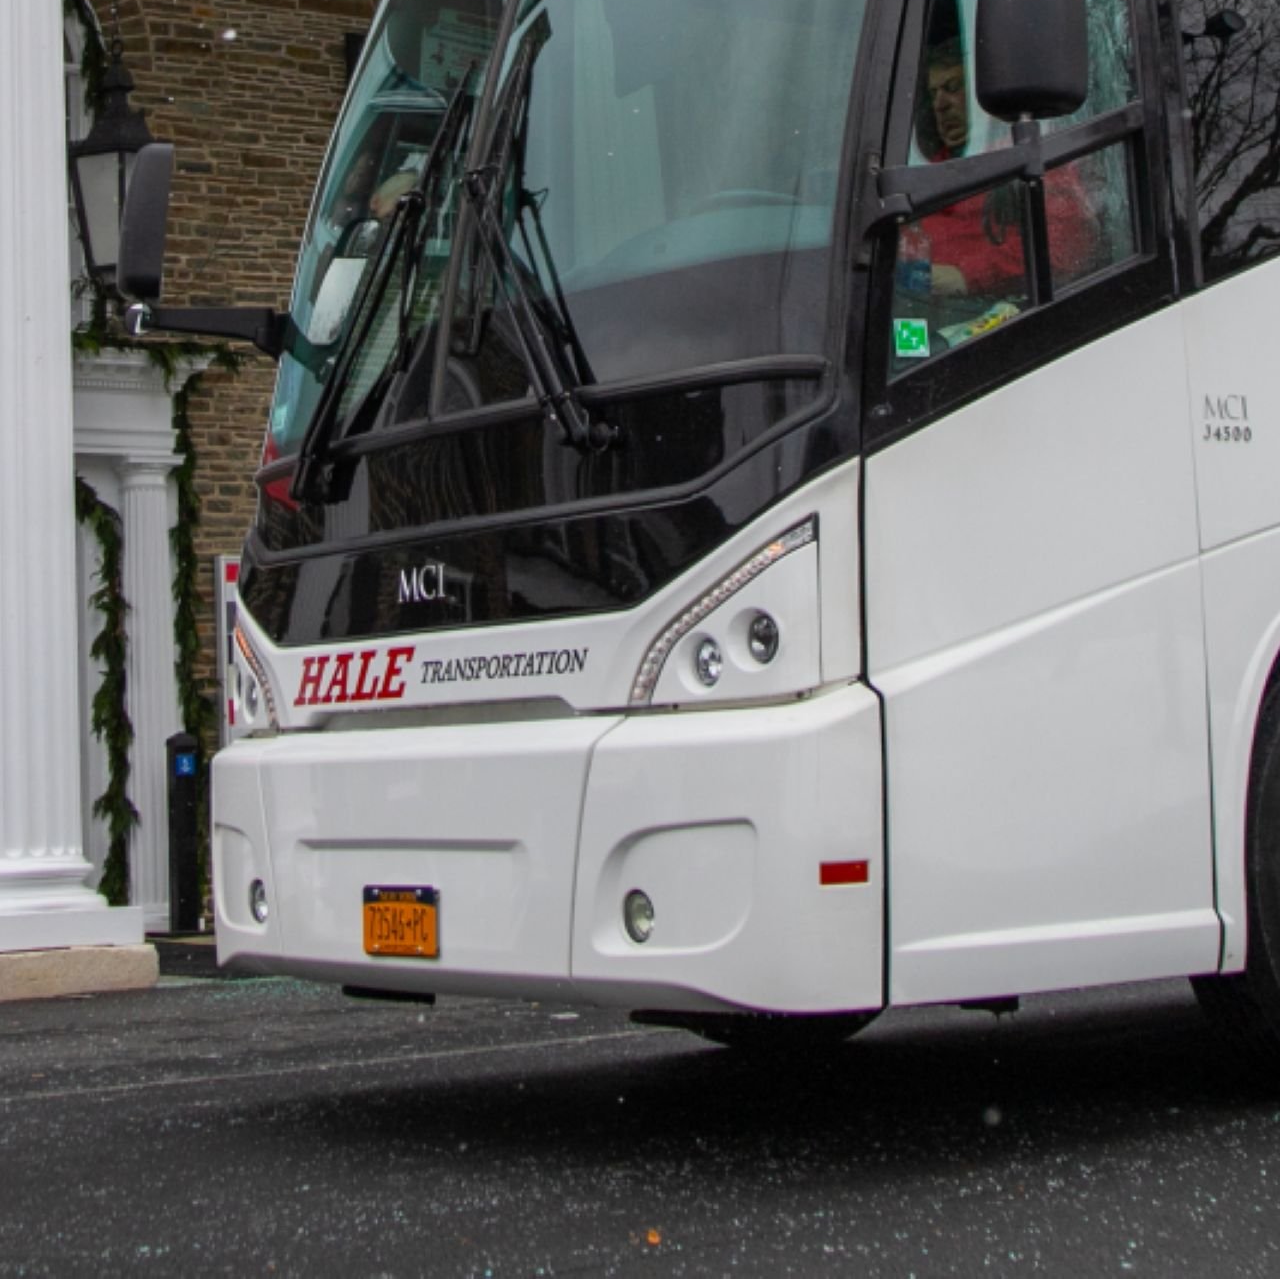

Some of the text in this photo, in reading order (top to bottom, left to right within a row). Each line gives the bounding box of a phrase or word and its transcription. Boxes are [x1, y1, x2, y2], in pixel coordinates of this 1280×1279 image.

[1203, 393, 1249, 421] MCI
[397, 562, 447, 603] MCI
[293, 646, 589, 707] HALE TRANSPORTATION
